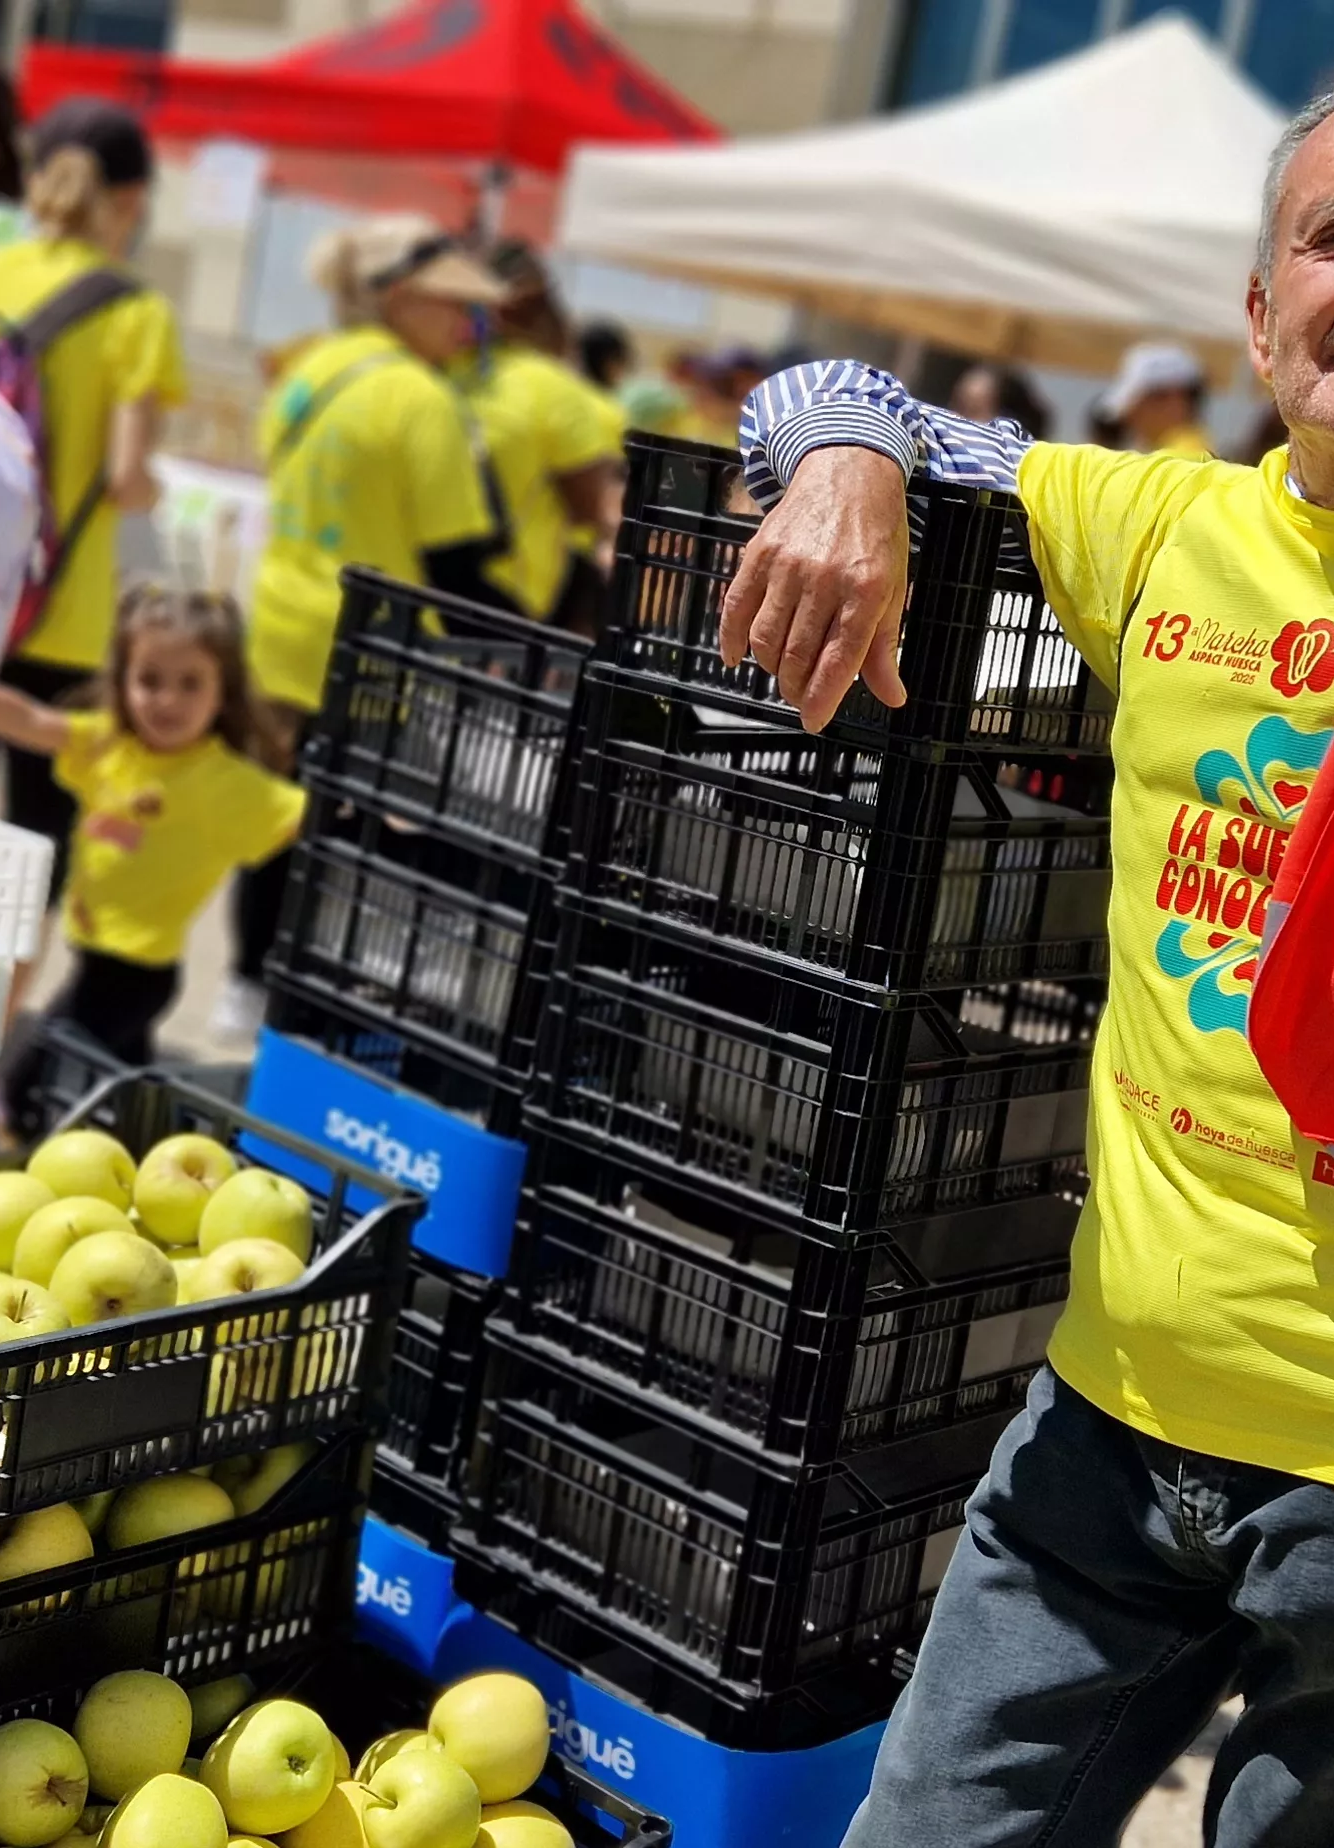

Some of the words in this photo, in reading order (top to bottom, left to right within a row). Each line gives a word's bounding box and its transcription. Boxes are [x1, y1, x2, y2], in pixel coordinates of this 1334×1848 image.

[1195, 617, 1271, 659] Marcha
[1187, 649, 1224, 667] ASPACE
[1223, 655, 1263, 673] HUESCA
[1229, 671, 1257, 686] 2025
[1167, 803, 1215, 863] LA
[1194, 1118, 1226, 1143] hoya
[1226, 1134, 1244, 1148] de
[1245, 1137, 1297, 1164] huesca
